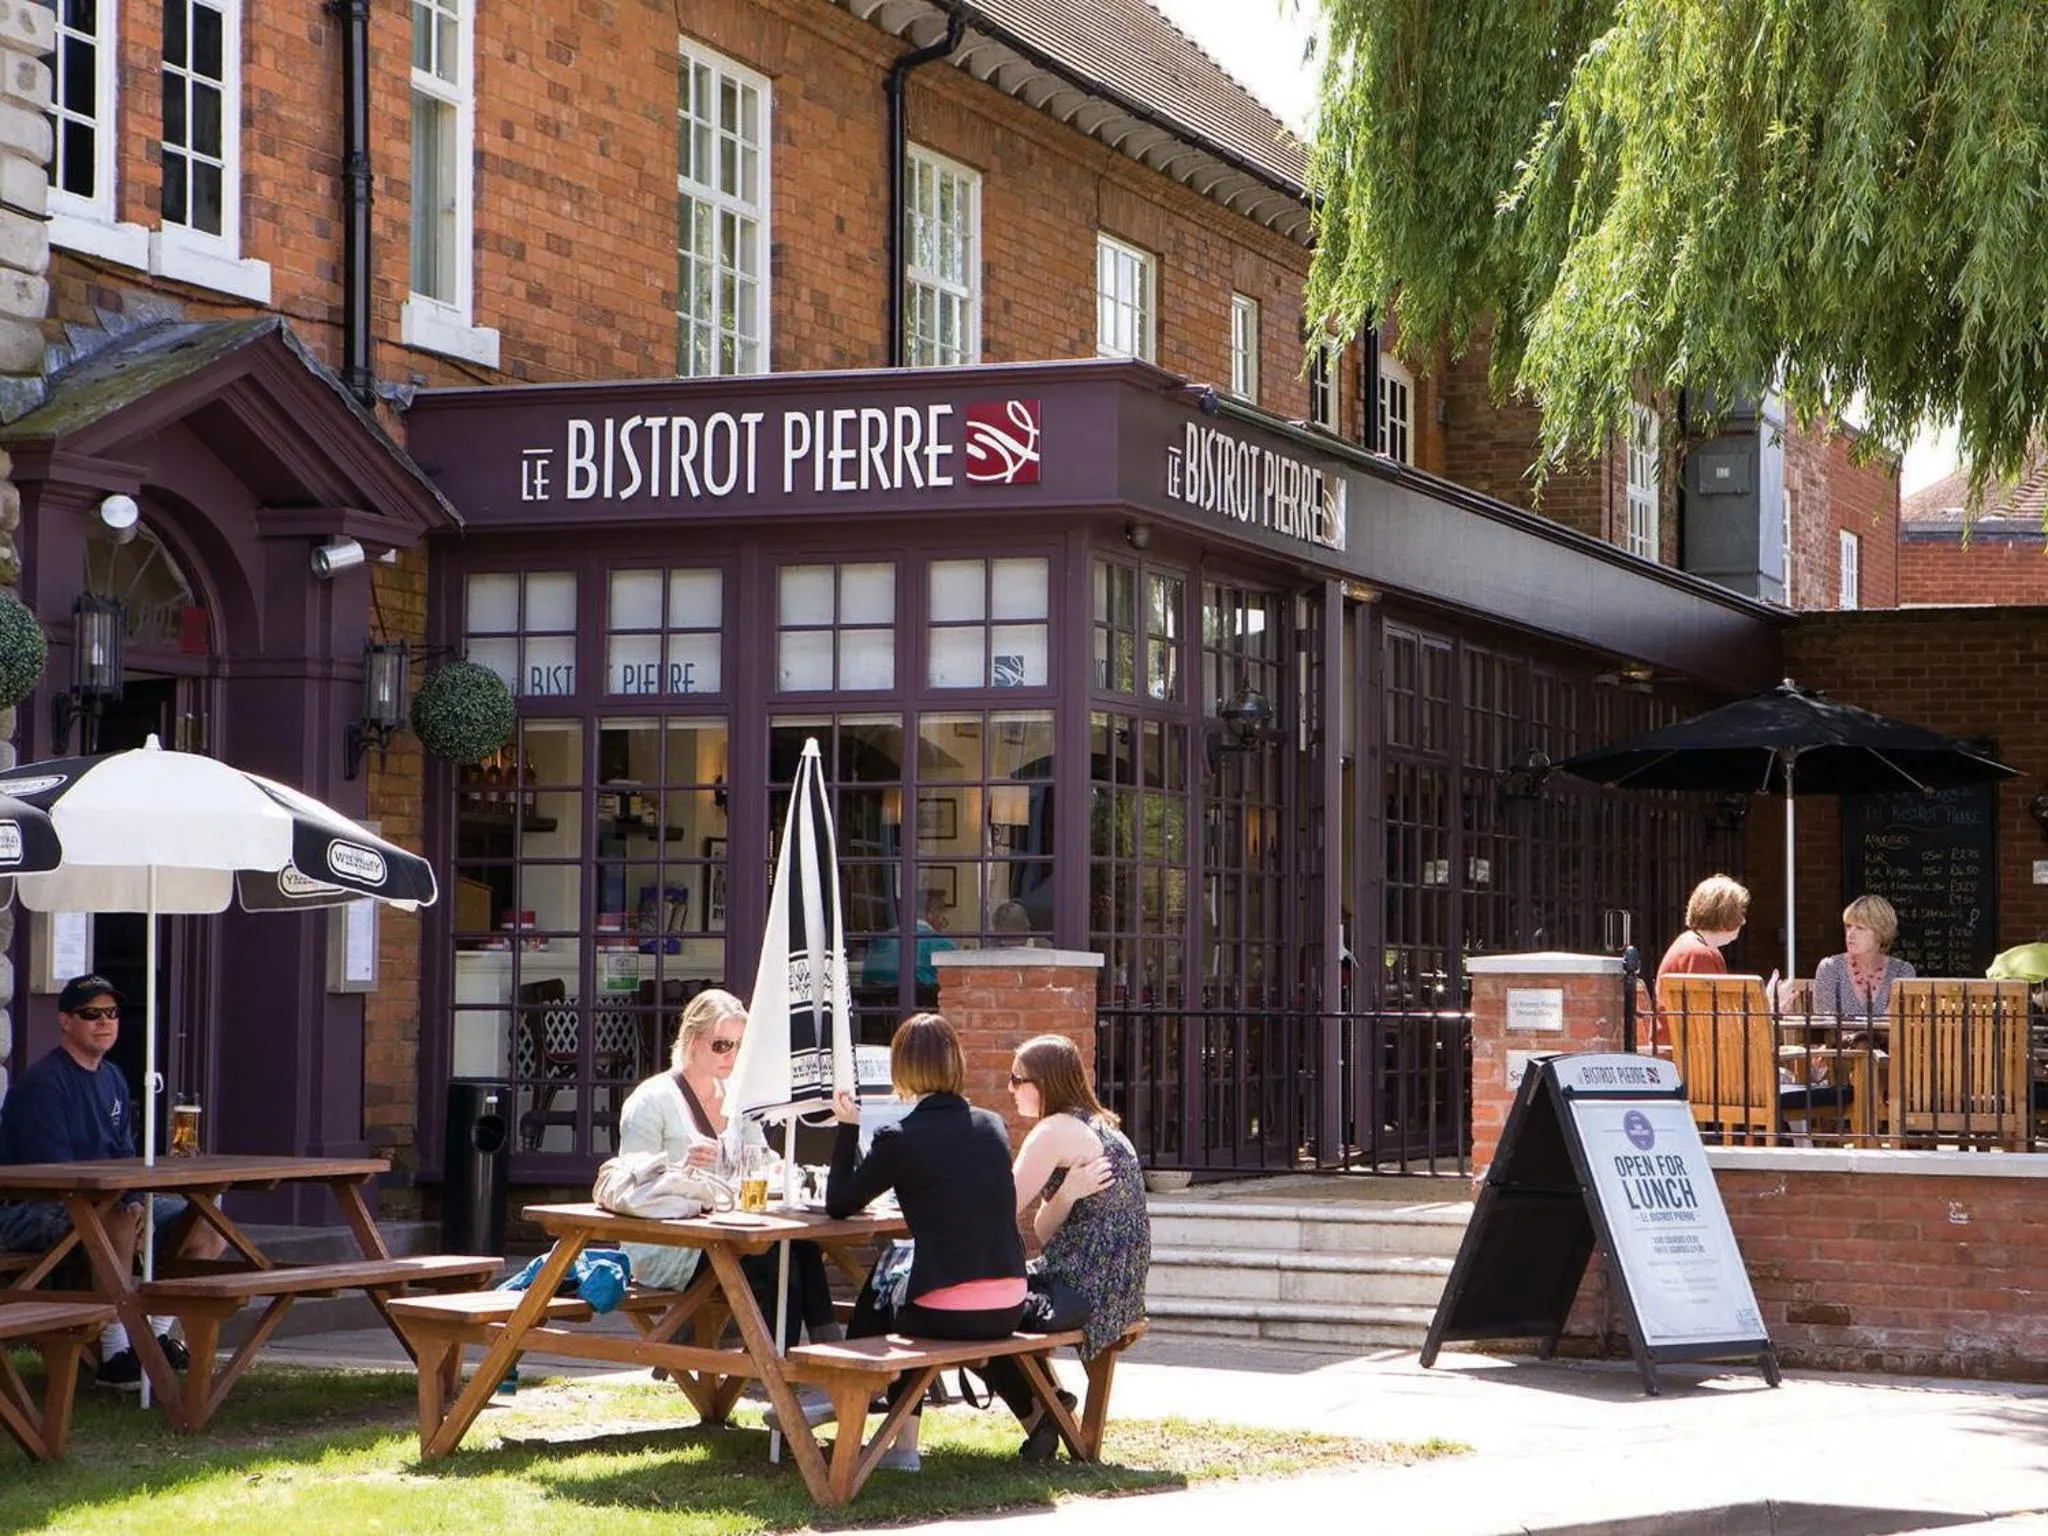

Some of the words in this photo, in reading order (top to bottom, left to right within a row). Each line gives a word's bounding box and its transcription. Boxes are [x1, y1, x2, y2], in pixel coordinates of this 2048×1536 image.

[522, 450, 553, 500] LE
[567, 413, 764, 500] BISTROT
[784, 404, 954, 493] PIERRE
[1168, 446, 1182, 499] LE
[1185, 422, 1260, 523] BISTROT
[1264, 450, 1323, 544] PIERRE
[623, 663, 695, 695] PIERE
[1614, 1155, 1655, 1177] OPEN
[1656, 1155, 1687, 1176] FOR
[1622, 1178, 1698, 1209] LUNCH
